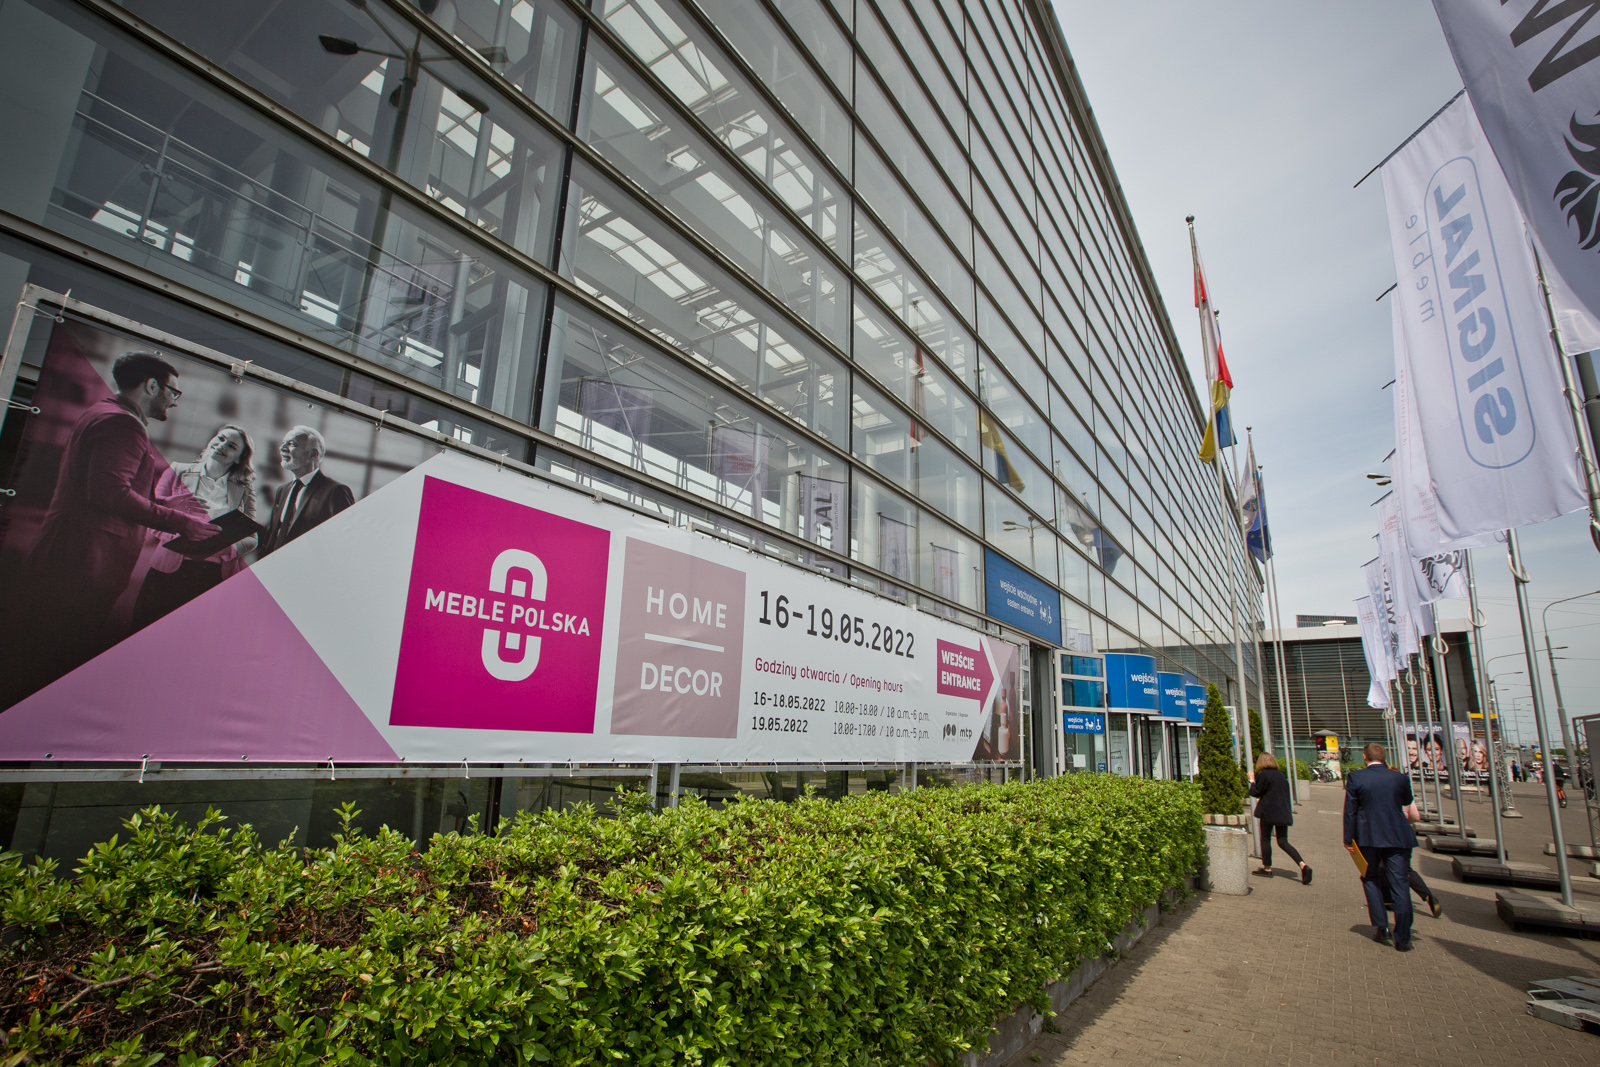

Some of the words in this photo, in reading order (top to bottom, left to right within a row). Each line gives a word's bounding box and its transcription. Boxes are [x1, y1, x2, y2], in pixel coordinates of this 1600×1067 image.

[425, 588, 506, 622] MEBLE
[510, 604, 590, 637] POLSKA
[646, 586, 727, 629] HOME
[759, 590, 915, 659] 16-19.05.2022
[941, 649, 975, 671] WEJŚCIE
[640, 662, 723, 697] DECOR
[755, 657, 797, 680] Godziny
[800, 666, 840, 684] otwarcia
[850, 674, 881, 692] Opening
[883, 679, 903, 693] hours
[941, 670, 981, 692] ENTRANCE
[753, 691, 826, 712] 16-18.05.2022
[834, 700, 878, 717] 10.00-18.00
[887, 706, 895, 718] 10
[752, 716, 809, 733] 19.05.2022
[886, 726, 894, 738] 10
[959, 728, 972, 740] mtp
